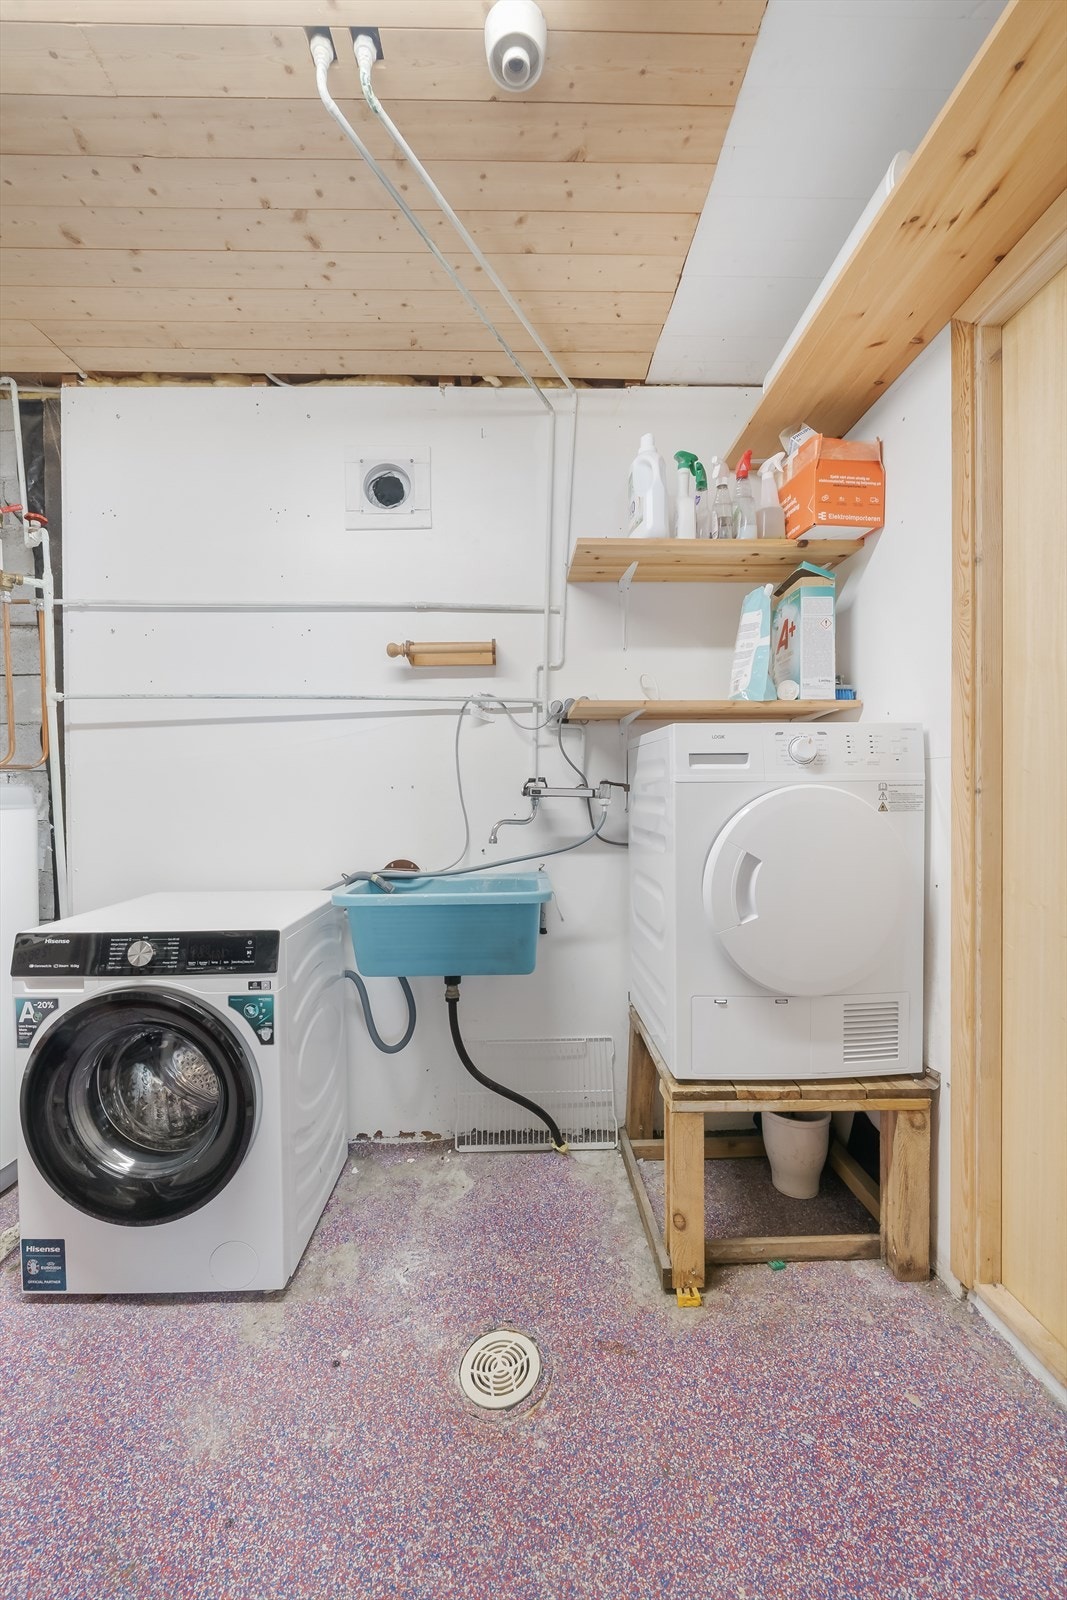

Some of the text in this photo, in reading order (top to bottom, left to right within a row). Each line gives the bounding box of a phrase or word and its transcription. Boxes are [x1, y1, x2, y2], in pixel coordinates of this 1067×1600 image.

[775, 618, 796, 656] A+
[19, 1001, 54, 1023] A -20%
